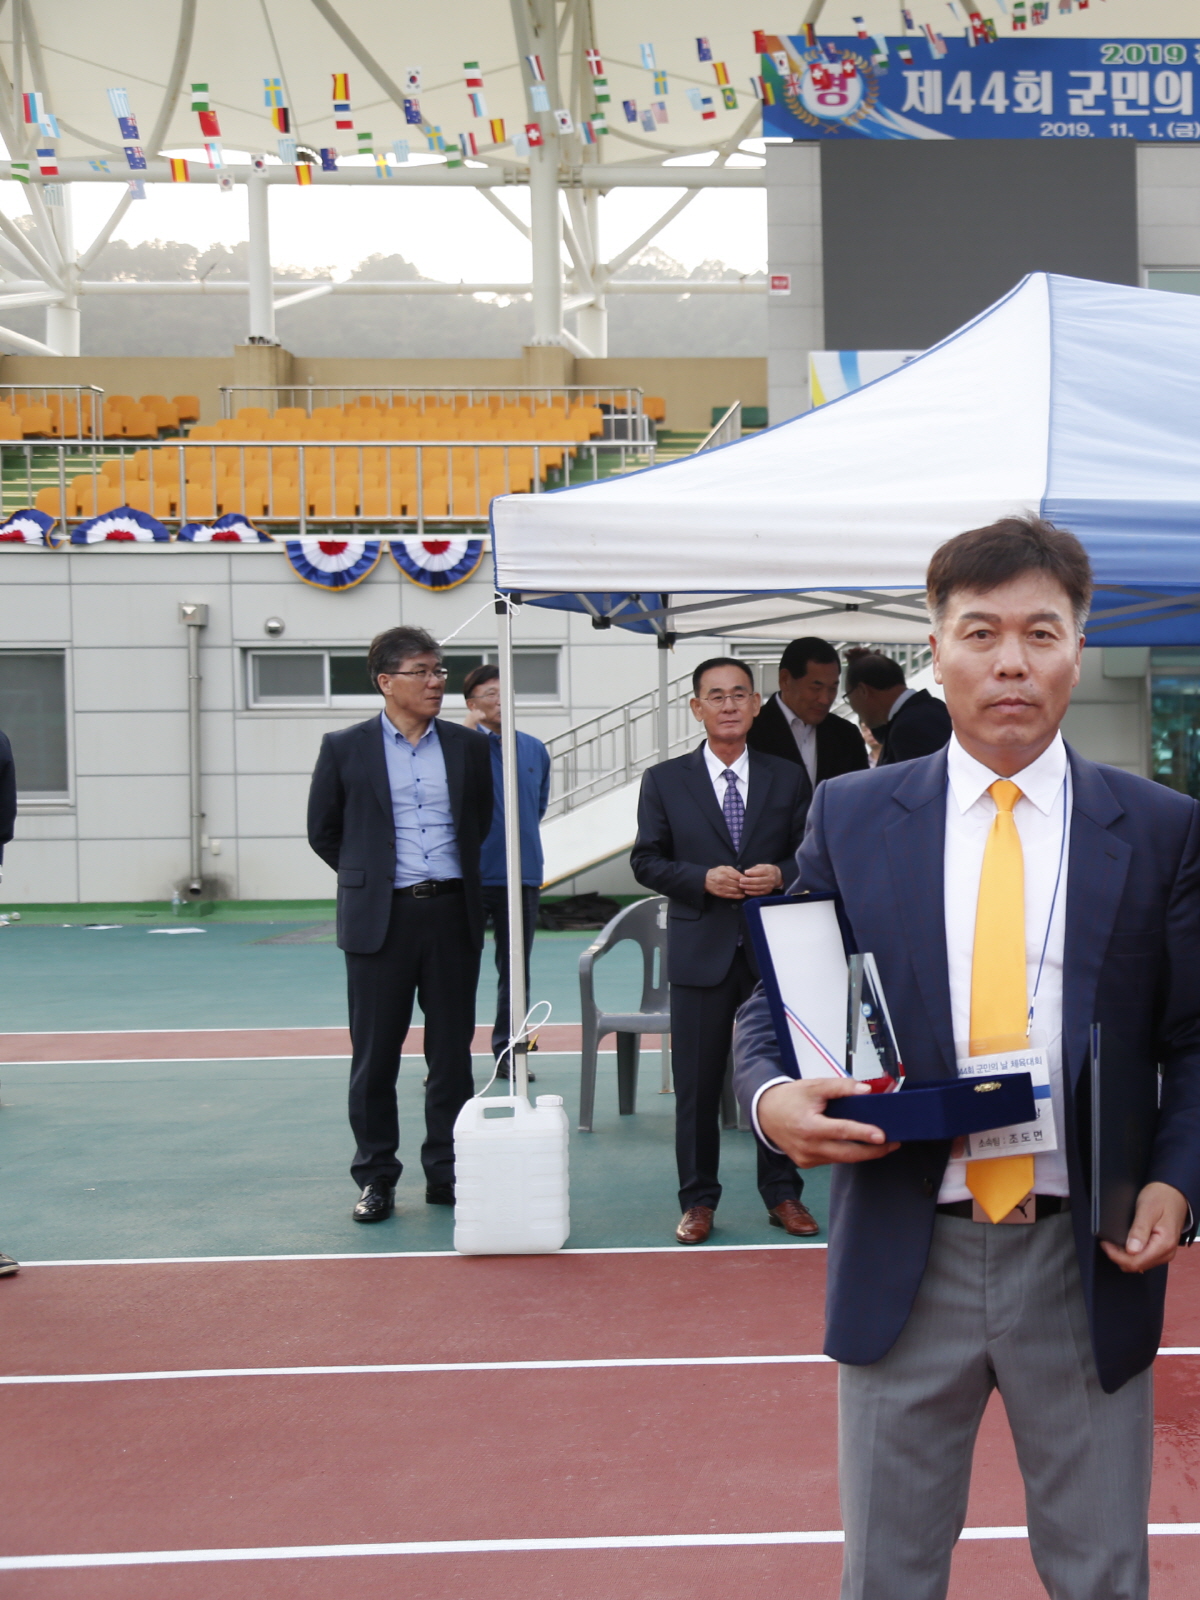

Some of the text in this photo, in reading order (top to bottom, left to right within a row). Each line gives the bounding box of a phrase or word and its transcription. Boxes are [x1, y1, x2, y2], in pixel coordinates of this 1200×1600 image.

[1099, 43, 1188, 66] 2019
[902, 70, 1054, 116] 제44회
[1066, 70, 1195, 116] 군민의
[1040, 123, 1096, 138] 2019.
[1110, 123, 1134, 138] 11.
[977, 1062, 998, 1074] 군민의
[1000, 1060, 1009, 1070] 날
[1011, 1057, 1042, 1068] 체육대회
